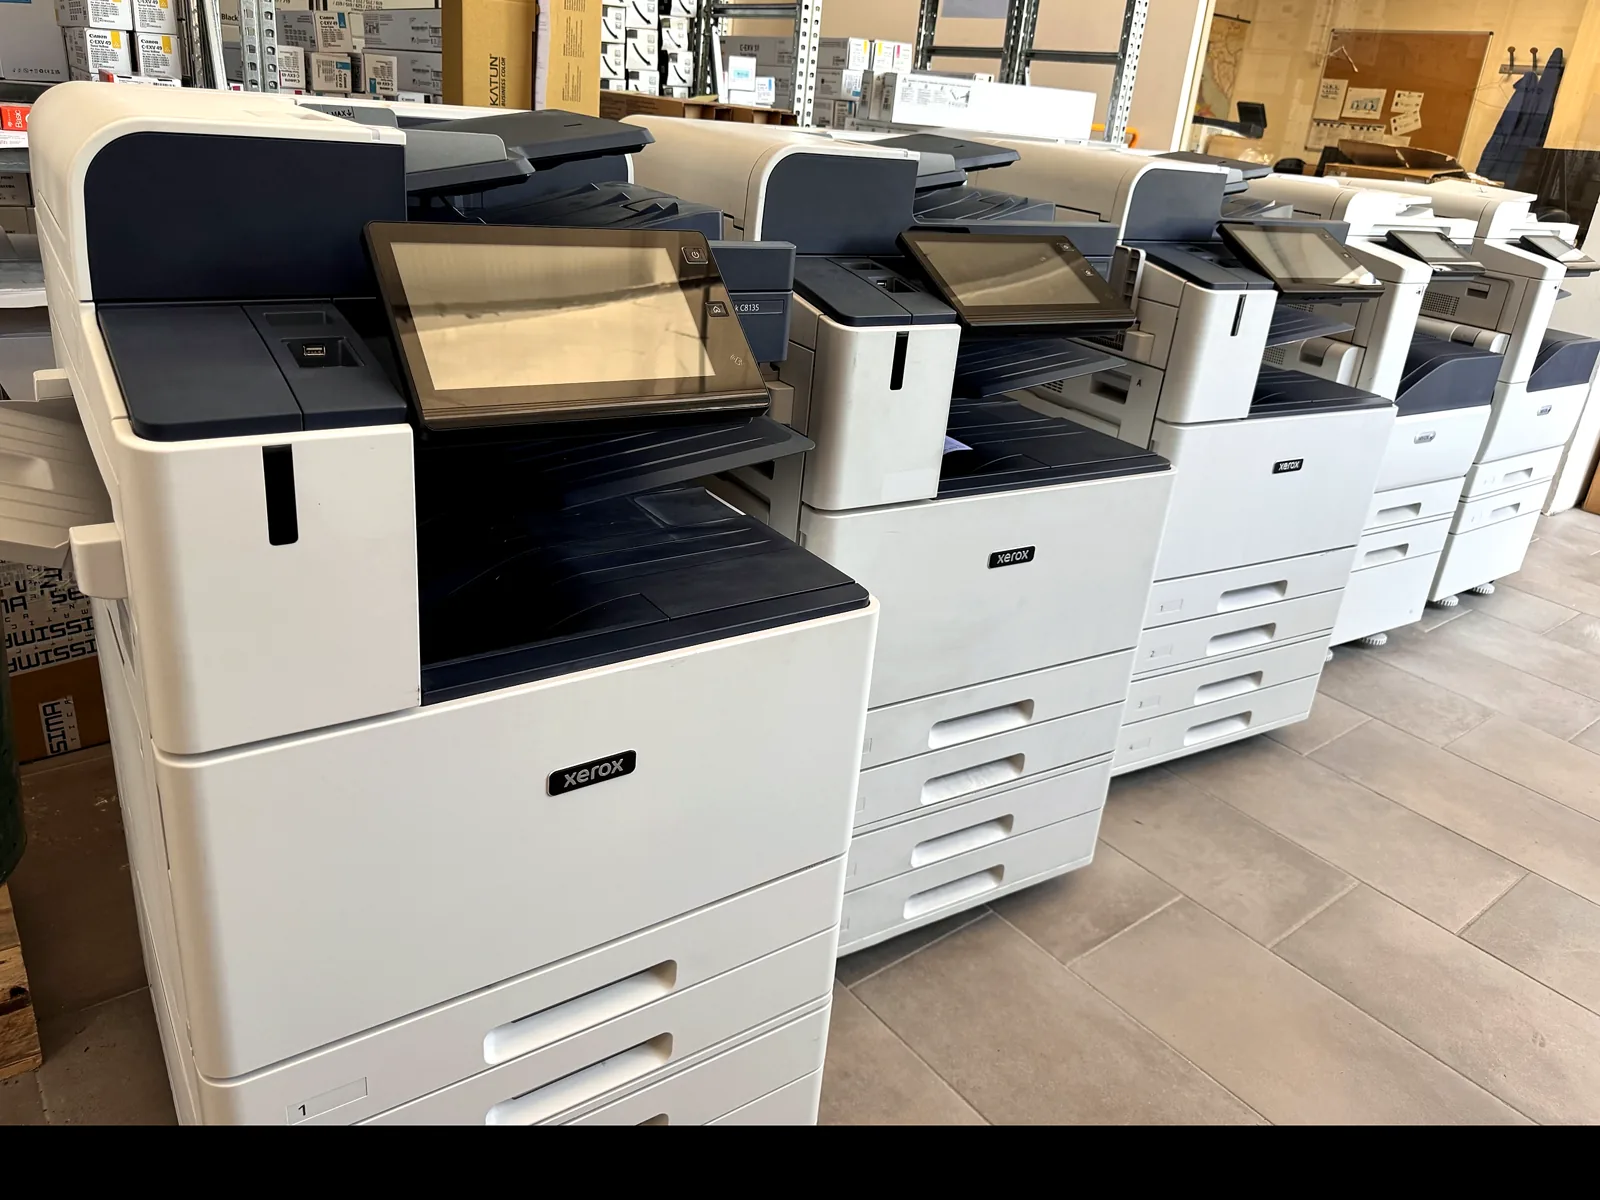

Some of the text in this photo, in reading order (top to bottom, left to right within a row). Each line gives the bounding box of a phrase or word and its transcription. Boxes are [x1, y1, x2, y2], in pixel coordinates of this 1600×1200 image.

[221, 13, 239, 21] Black
[489, 56, 499, 106] KATUN
[15, 109, 23, 128] Basic
[739, 303, 760, 312] C8135
[1278, 460, 1300, 471] xerox
[997, 549, 1029, 564] xerox
[563, 758, 624, 788] xerox
[298, 1103, 306, 1116] 1
